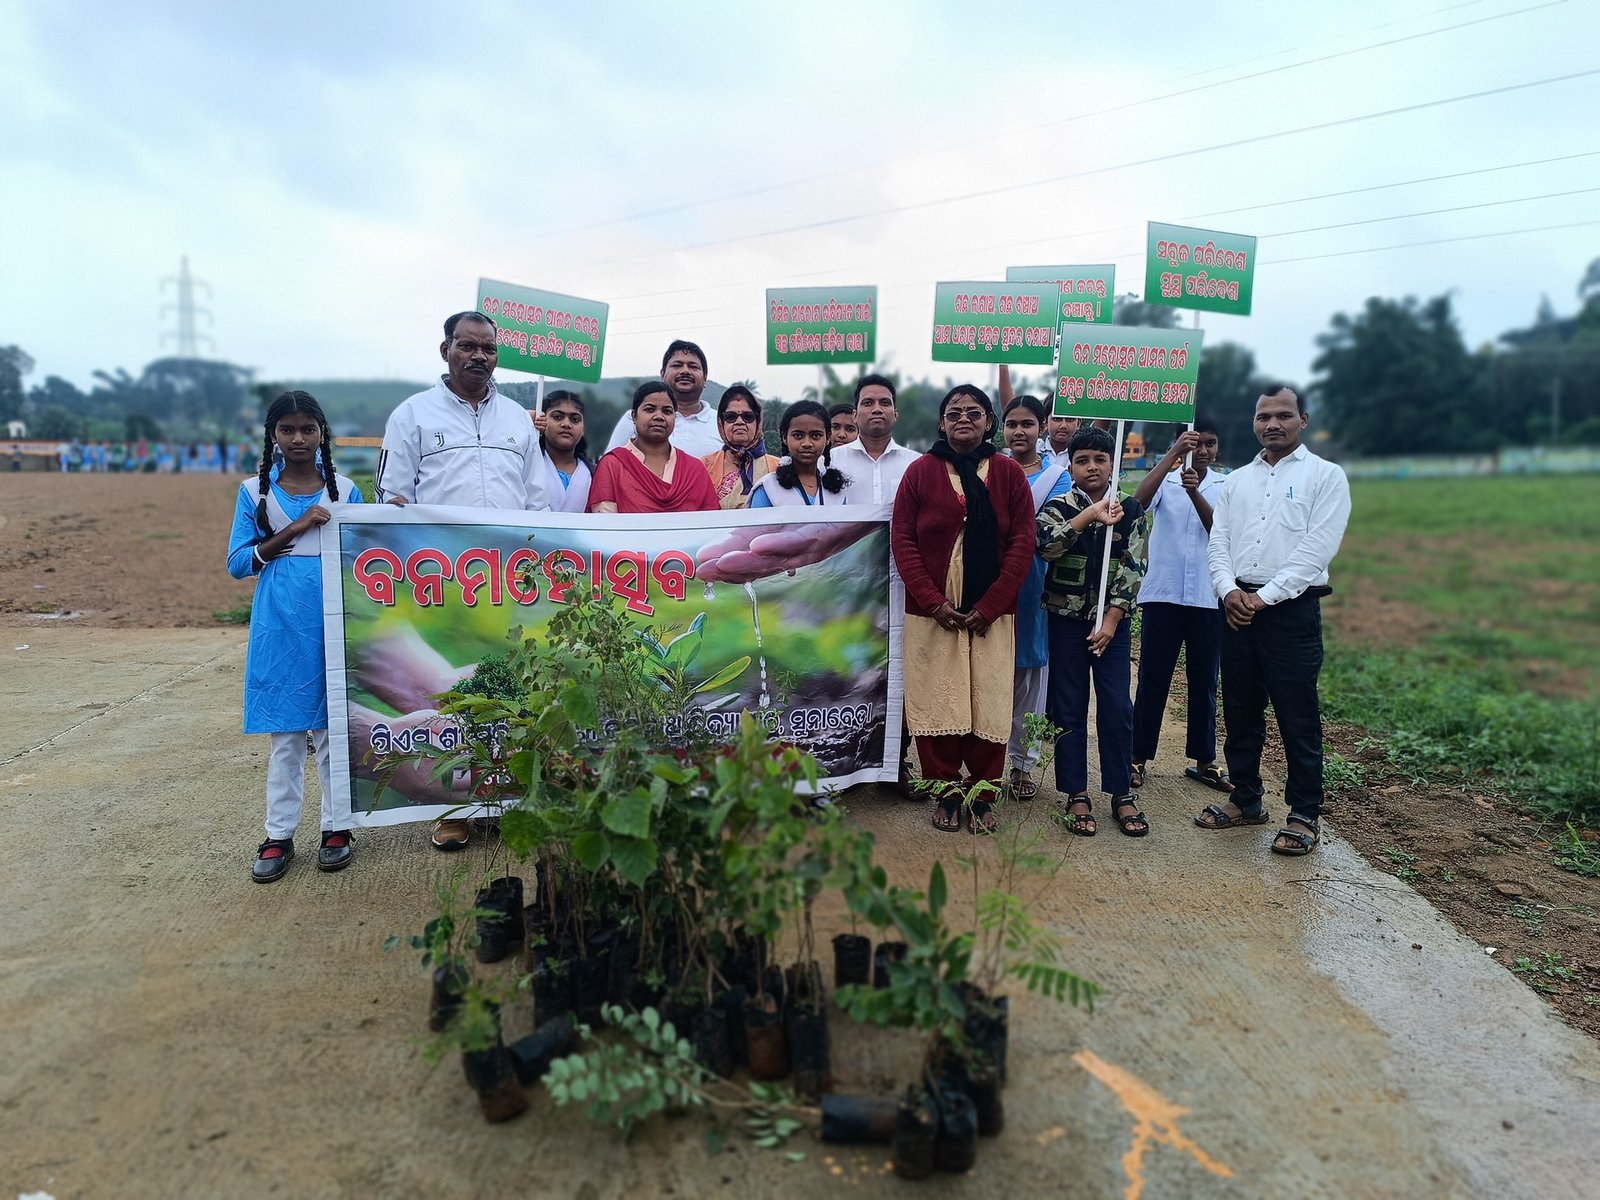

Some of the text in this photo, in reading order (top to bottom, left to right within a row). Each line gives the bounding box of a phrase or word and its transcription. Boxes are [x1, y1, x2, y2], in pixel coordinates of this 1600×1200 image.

[1156, 240, 1247, 270] ସବୁଜ ପରିବେଶ
[1076, 278, 1106, 298] କରନ୍ତୁ
[1185, 270, 1239, 301] ପରିବେଶ
[482, 296, 500, 315] ବନ
[502, 299, 543, 327] ମହୋତ୍ସବ
[573, 314, 600, 341] କରନ୍ତୁ
[954, 294, 969, 314] ଗଛ
[999, 295, 1014, 314] ଗଛ
[789, 327, 821, 353] ପରିବେଶ
[934, 324, 951, 345] ଆମ
[978, 326, 1000, 351] ସବୁଜ
[1073, 341, 1191, 371] ବନ ମହୋତ୍ସବ ଆମର ପର୍ବ
[1059, 376, 1085, 405] ସବୁଜ
[1087, 371, 1130, 401] ପରିବେଶ
[1131, 380, 1160, 405] ଆମର
